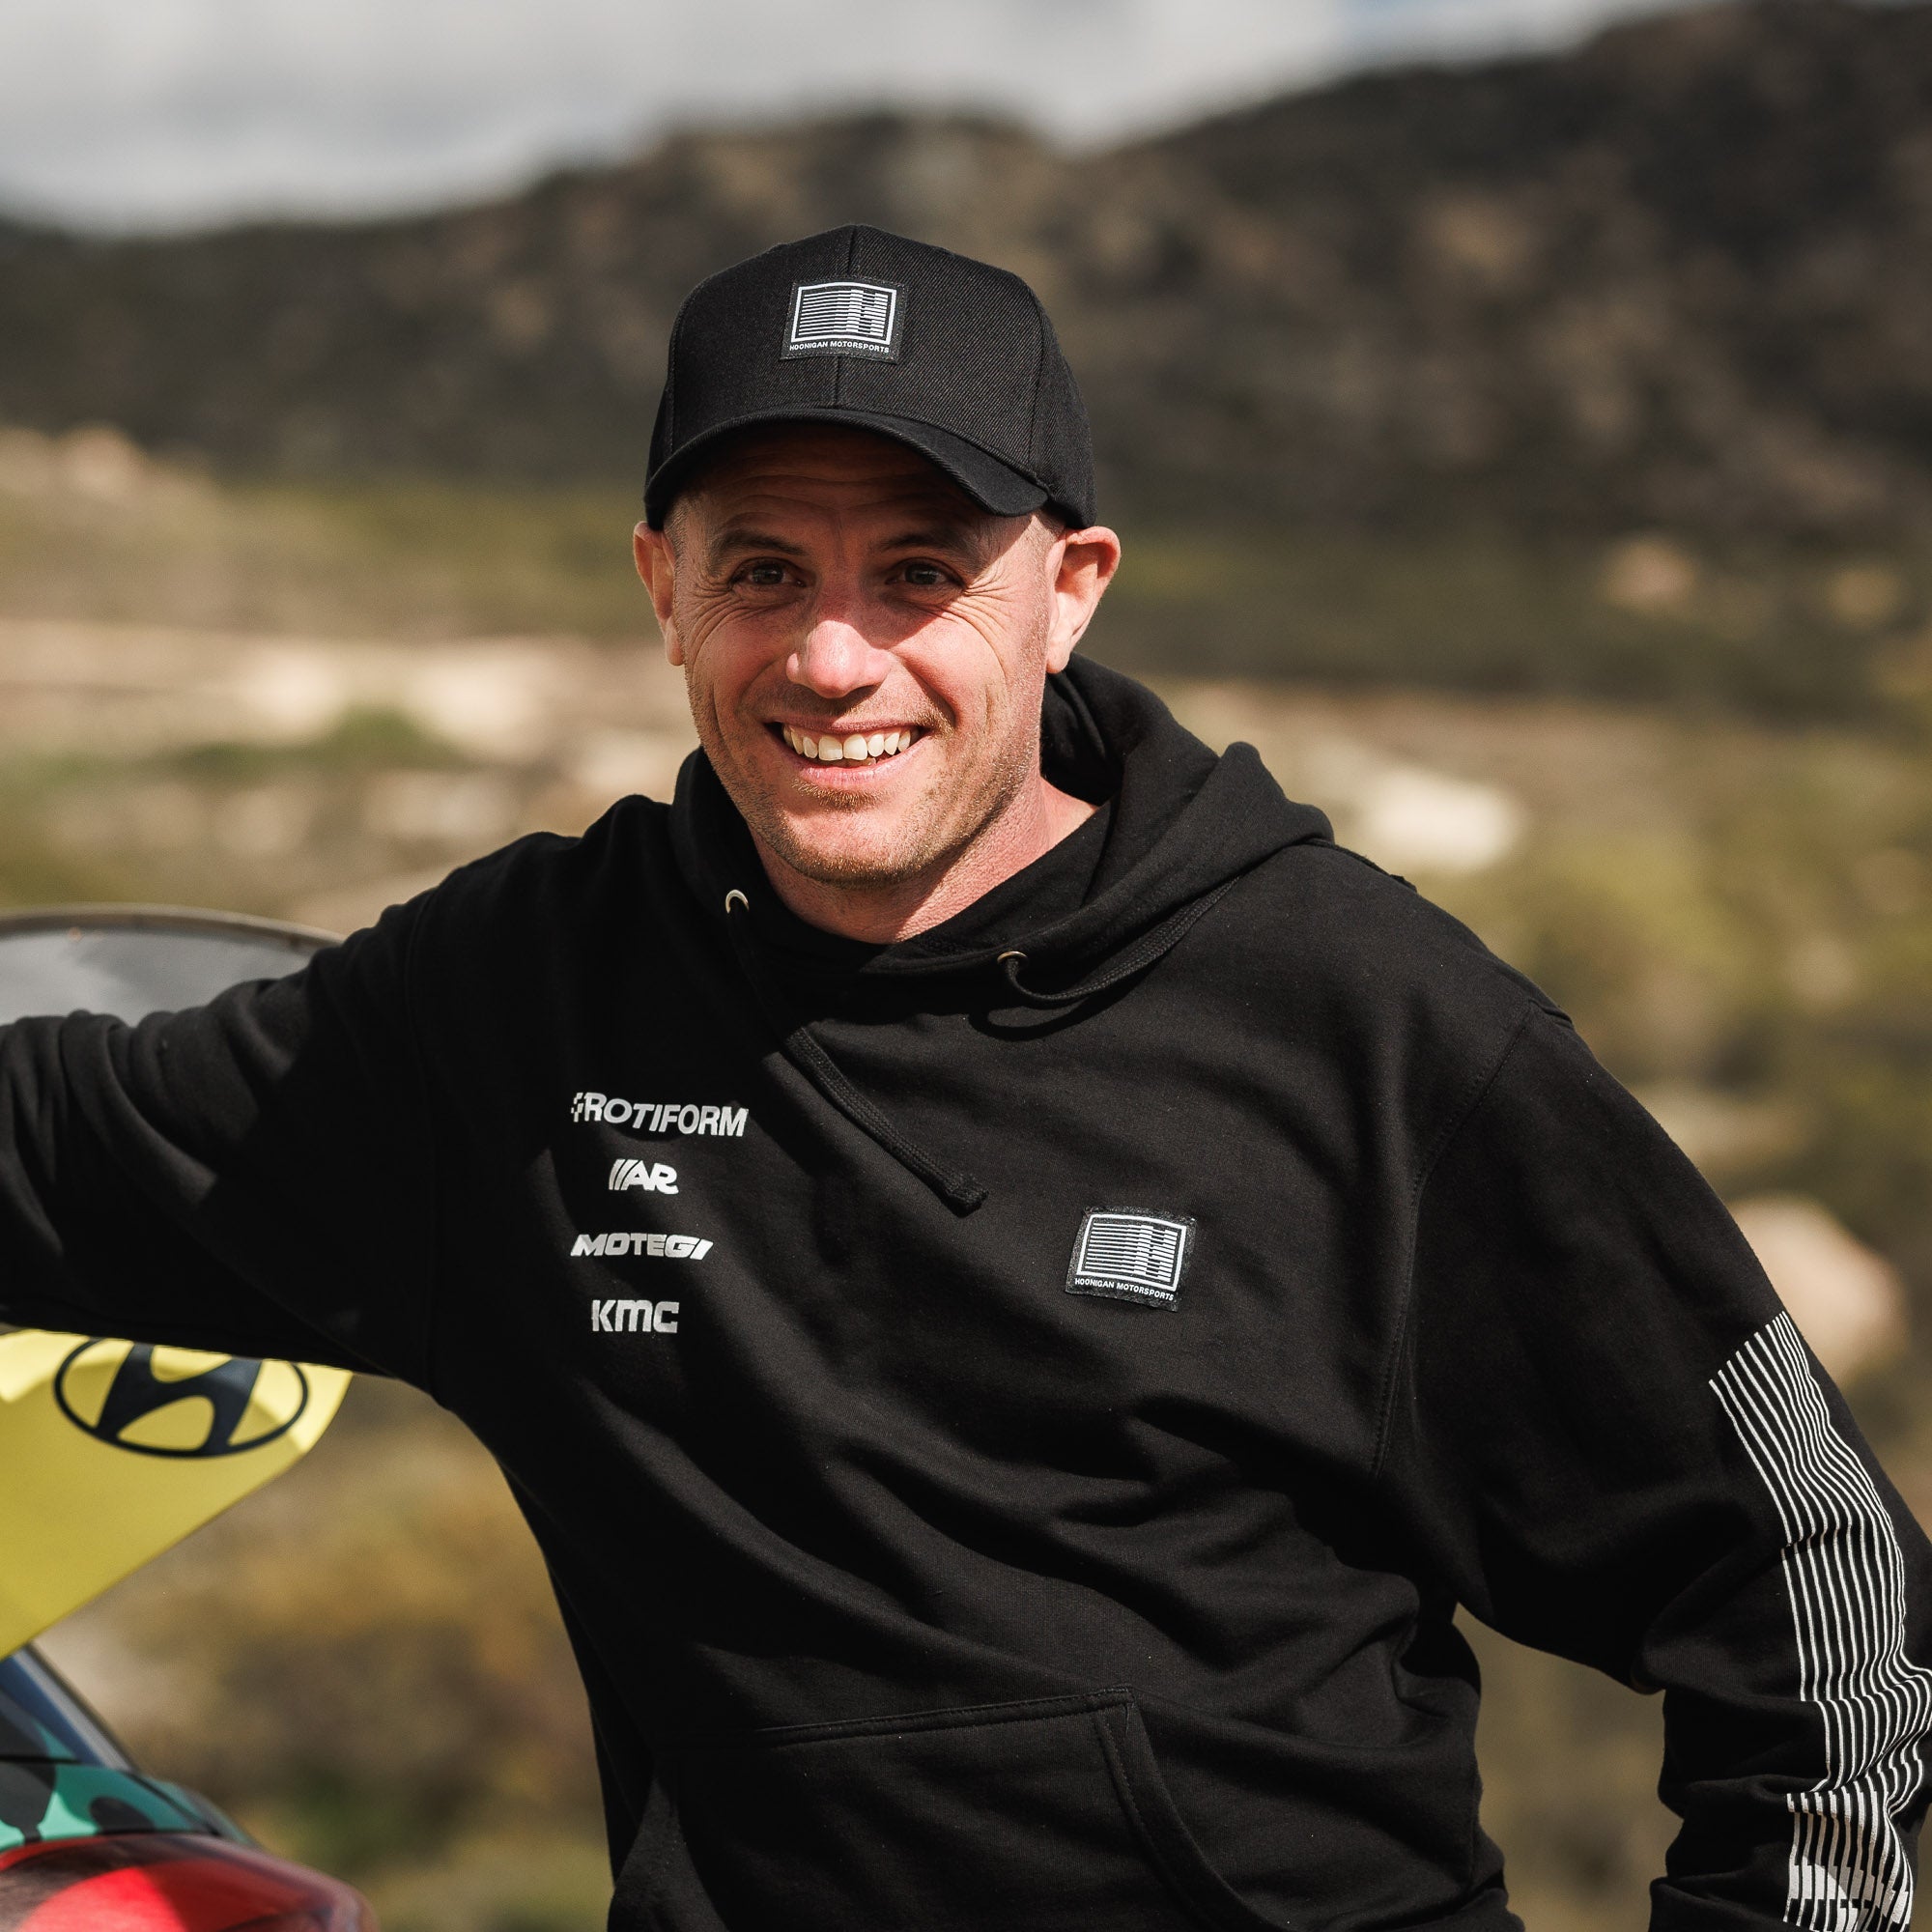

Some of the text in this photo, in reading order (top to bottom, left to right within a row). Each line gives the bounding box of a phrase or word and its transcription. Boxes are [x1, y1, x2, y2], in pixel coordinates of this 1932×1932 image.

[789, 340, 890, 354] HOONIGAN MOTORSPORTS
[583, 1092, 750, 1137] ROTIFORM
[570, 1233, 714, 1261] MOTEGI
[1074, 1277, 1175, 1301] HOONIGAN MOTORSPORTS
[591, 1299, 680, 1334] KMC
